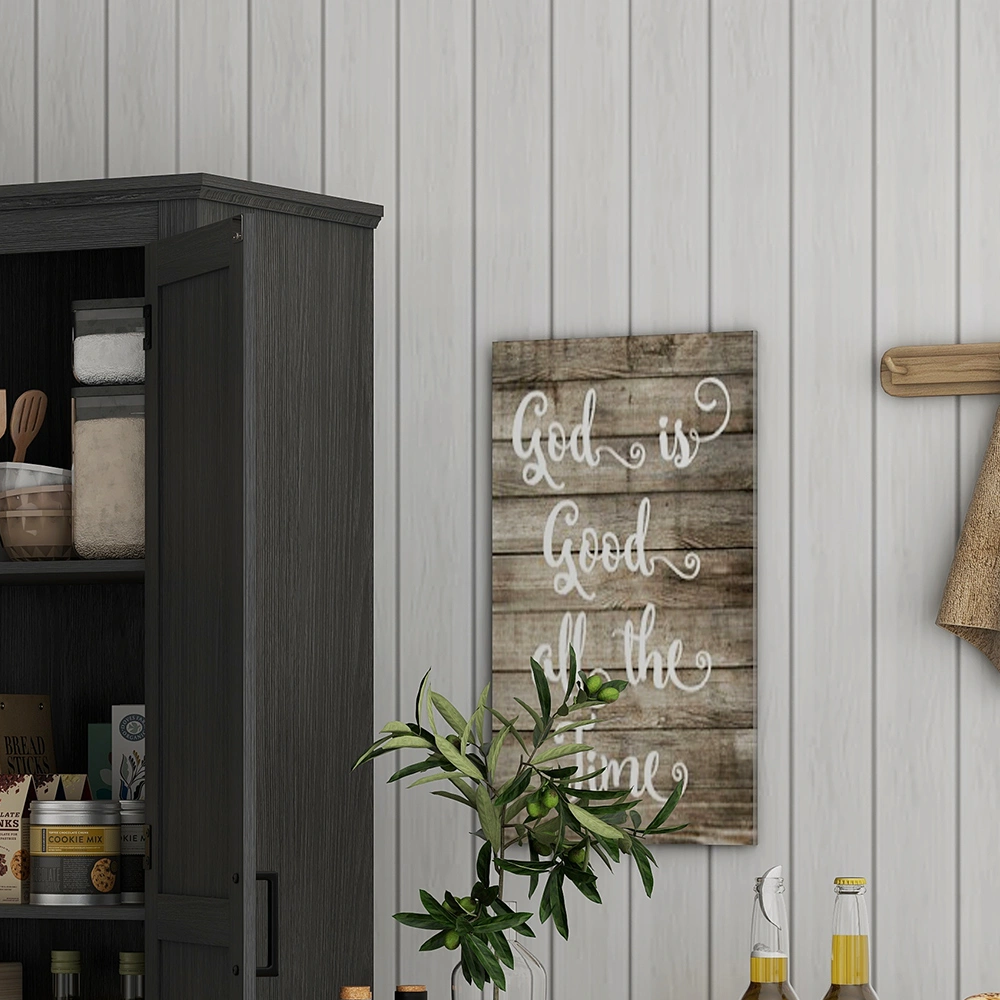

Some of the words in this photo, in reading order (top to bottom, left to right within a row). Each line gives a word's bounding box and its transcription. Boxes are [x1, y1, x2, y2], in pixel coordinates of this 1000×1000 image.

[512, 388, 646, 490] God
[658, 377, 731, 469] is
[543, 497, 701, 600] Good
[612, 602, 712, 692] the
[4, 735, 46, 755] BREAD
[7, 755, 50, 774] STICKS
[48, 835, 84, 843] COOKIE
[86, 835, 103, 843] MIX
